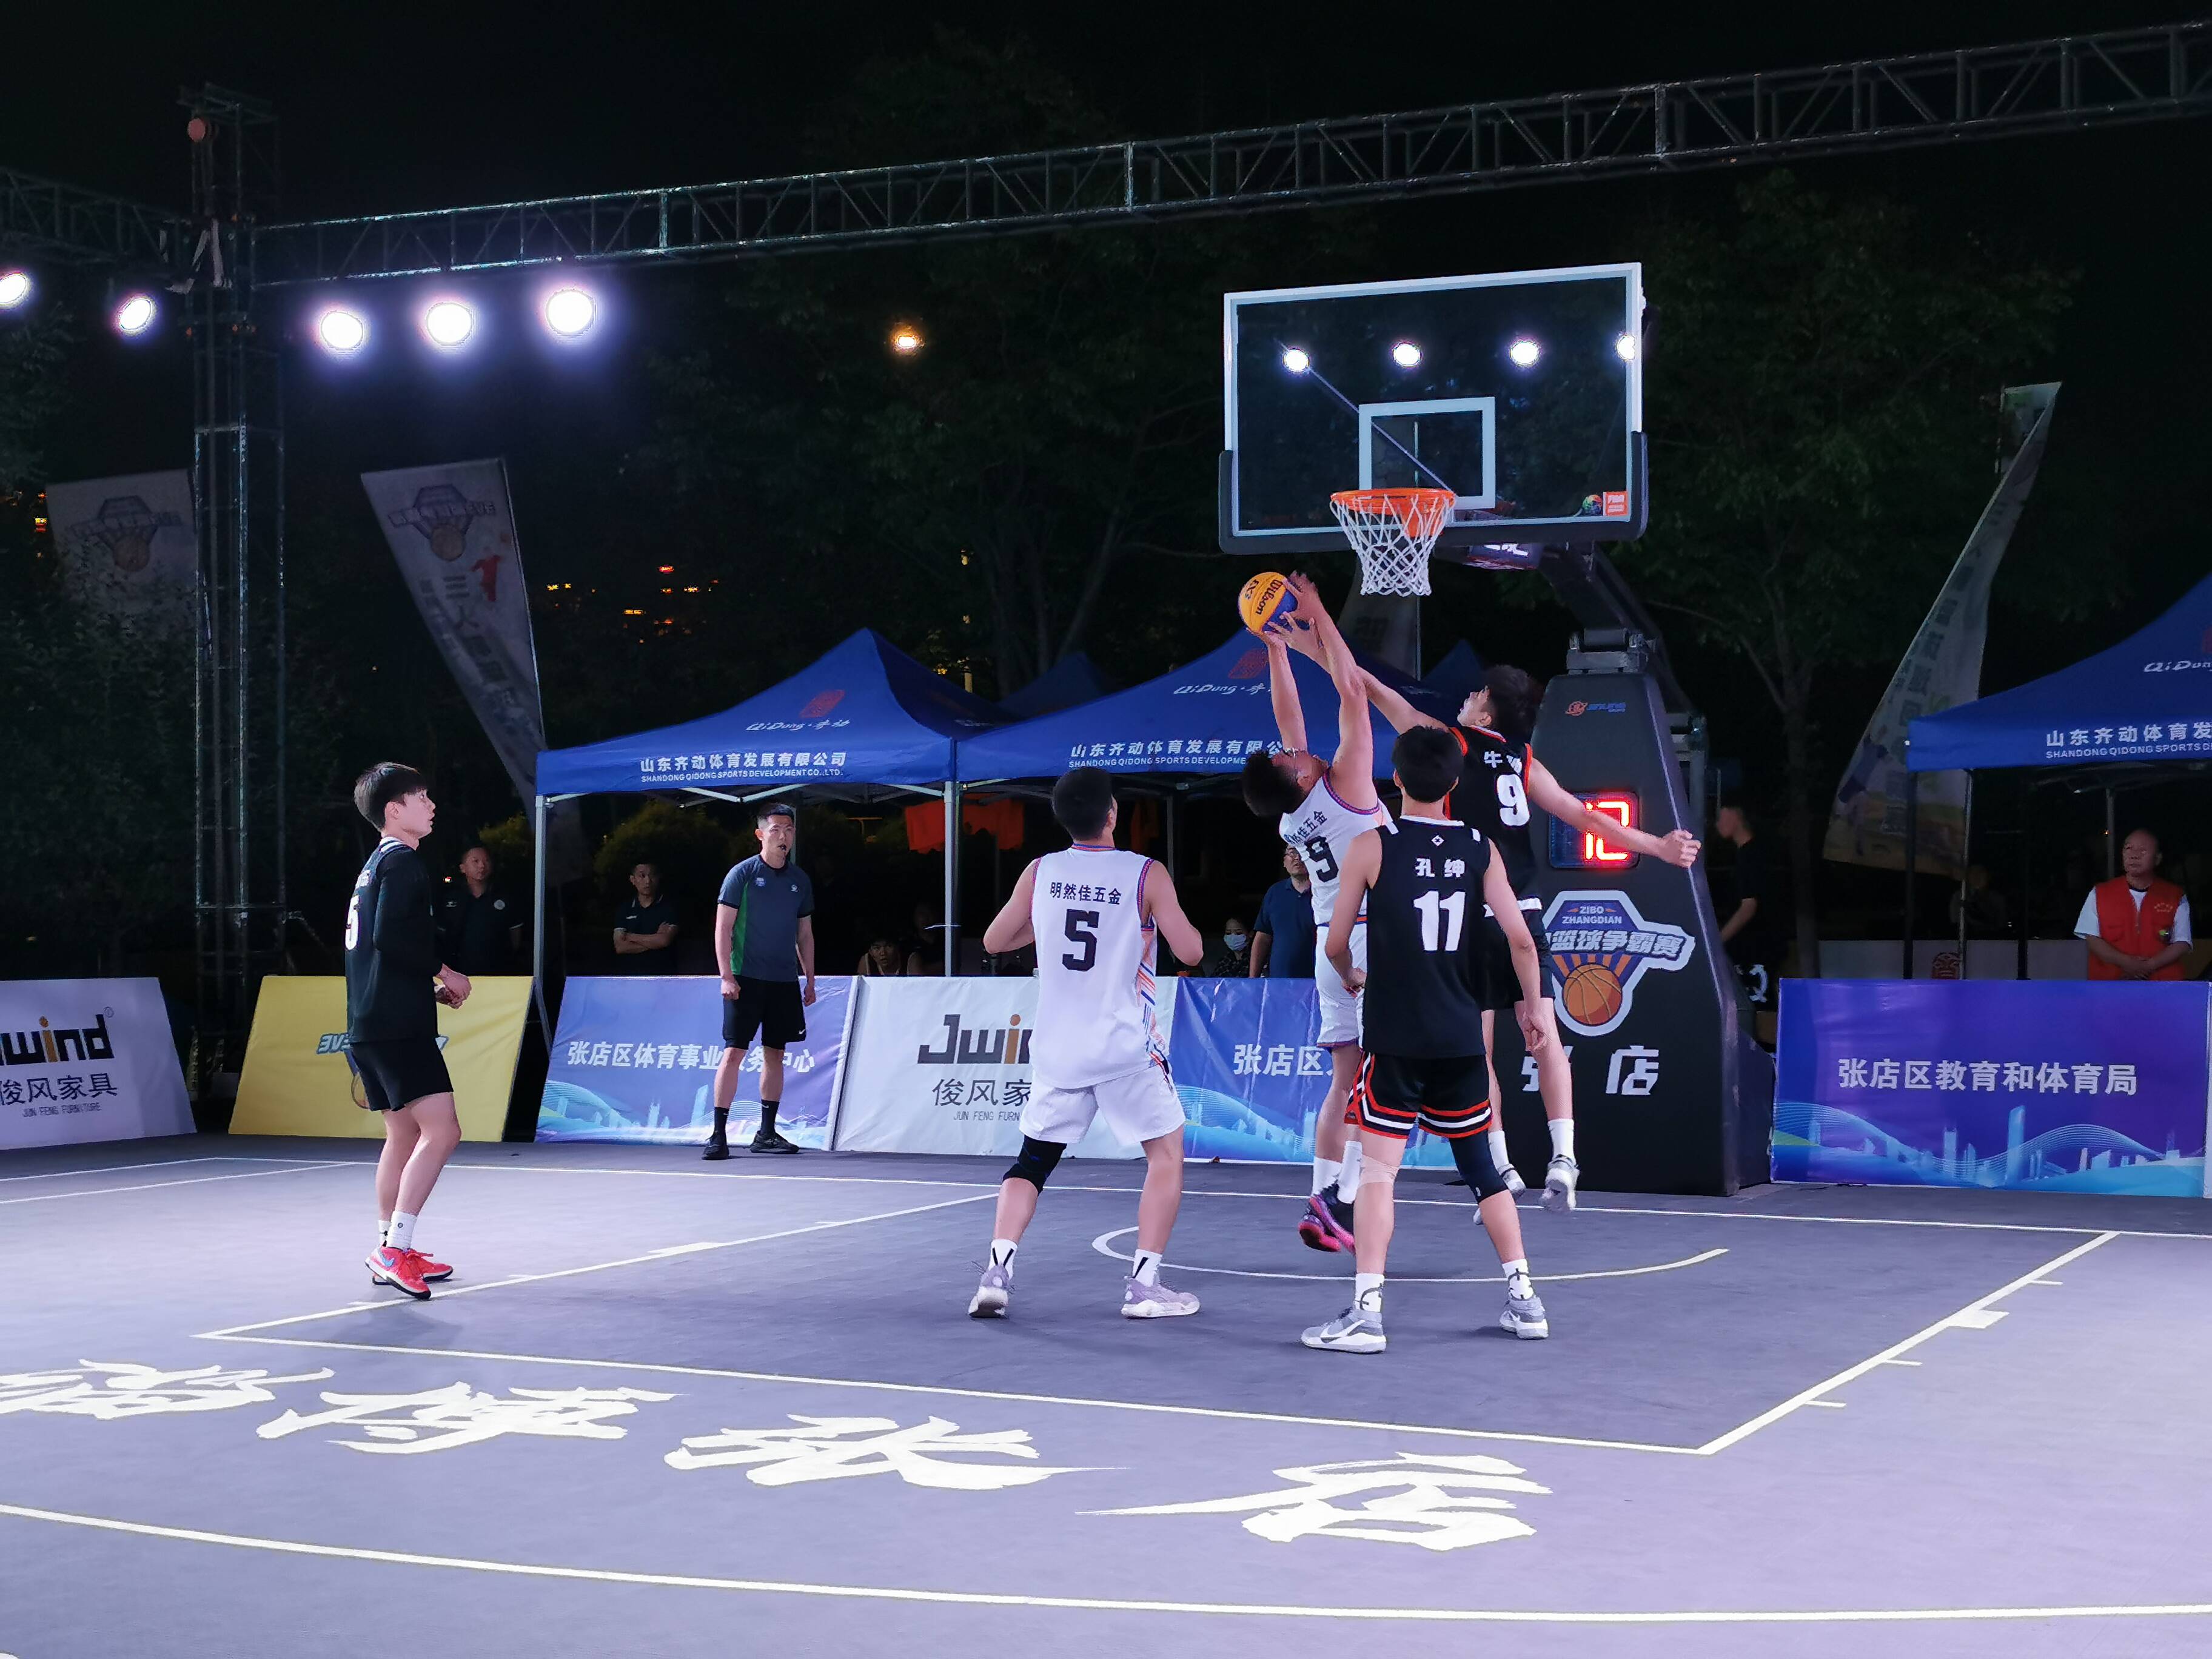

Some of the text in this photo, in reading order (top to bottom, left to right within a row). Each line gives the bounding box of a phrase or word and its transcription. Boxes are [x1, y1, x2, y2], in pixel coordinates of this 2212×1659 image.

[1255, 579, 1284, 615] Wilson
[640, 752, 846, 773] 山东齐动体育发展有限公司
[1068, 759, 1117, 768] SHANDONG
[1118, 757, 1153, 766] QIDONG
[1070, 739, 1284, 758] 山东齐动体育发展有限公
[2046, 748, 2108, 759] SHANDONG
[2108, 745, 2153, 757] QIDONG
[2155, 743, 2202, 753] SPORTS
[642, 773, 686, 783] SHANDONG
[685, 771, 717, 781] QIDONG
[717, 770, 748, 779] SPORTS
[749, 769, 807, 777] DEVELOPMENT
[1496, 774, 1530, 826] 9
[1304, 836, 1339, 883] 9
[1050, 881, 1122, 905] 明然佳五金
[1413, 891, 1466, 951] 11
[1562, 916, 1623, 924] ZHANGDIAN
[1062, 908, 1100, 972] 5
[1546, 930, 1684, 957] 篮球争霸赛
[0, 1014, 115, 1067] wind
[567, 1041, 816, 1073] 张店区体育事业务心
[1232, 1043, 1333, 1077] 张店区
[1838, 1057, 2138, 1096] 张店区教育和体育局
[932, 1078, 1033, 1107] 俊风家
[973, 1111, 994, 1121] FENG
